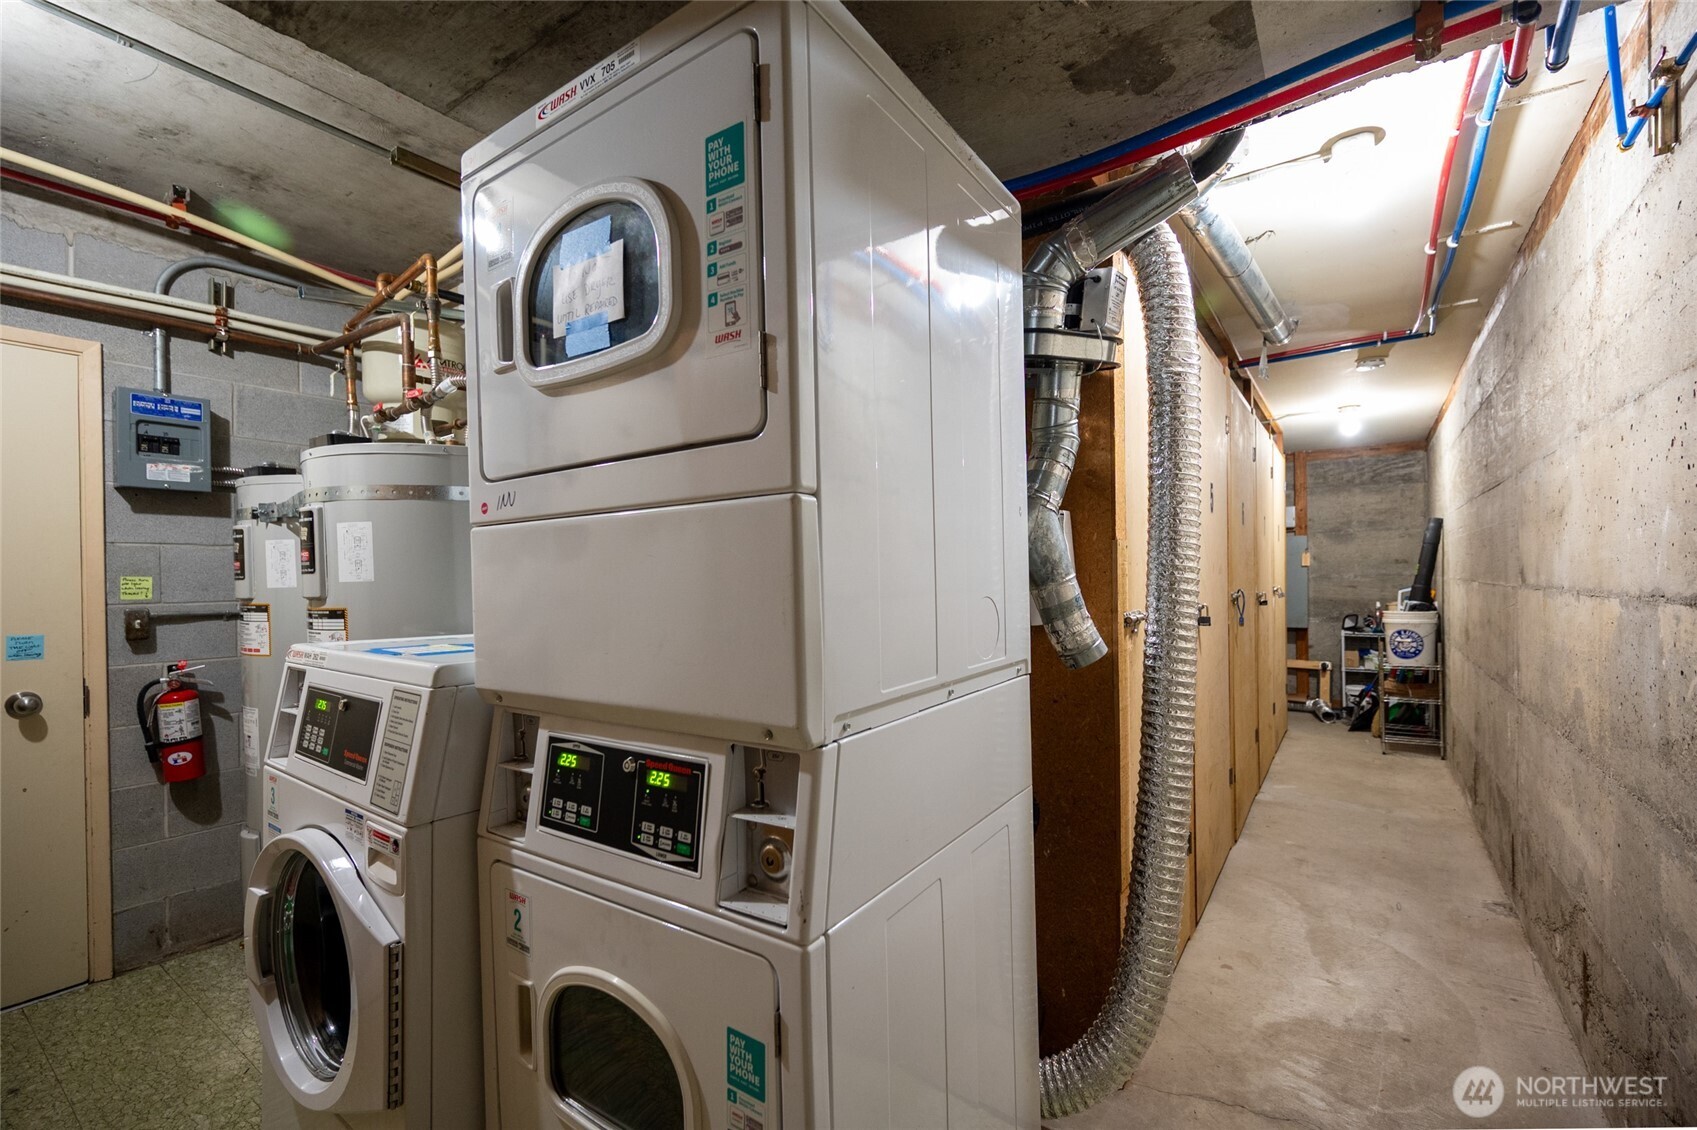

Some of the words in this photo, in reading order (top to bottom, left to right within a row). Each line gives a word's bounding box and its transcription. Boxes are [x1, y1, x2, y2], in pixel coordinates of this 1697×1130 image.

[550, 85, 577, 111] WASH
[579, 73, 596, 91] VVX
[601, 60, 616, 77] 705
[708, 136, 724, 152] PAY
[708, 144, 731, 162] WITH
[708, 154, 733, 171] YOUR
[708, 160, 740, 182] PHONE
[709, 245, 715, 254] 2
[561, 287, 578, 305] USE
[714, 329, 742, 344] WASH
[560, 753, 577, 768] 2.25
[645, 758, 668, 771] Speed
[668, 763, 692, 776] Queen
[649, 770, 671, 787] 2.25
[270, 786, 276, 805] 3
[509, 892, 526, 905] WASH
[514, 908, 522, 932] 2
[729, 1033, 746, 1049] PAY
[729, 1043, 752, 1062] WITH
[729, 1053, 754, 1073] YOUR
[729, 1063, 760, 1087] PHONE
